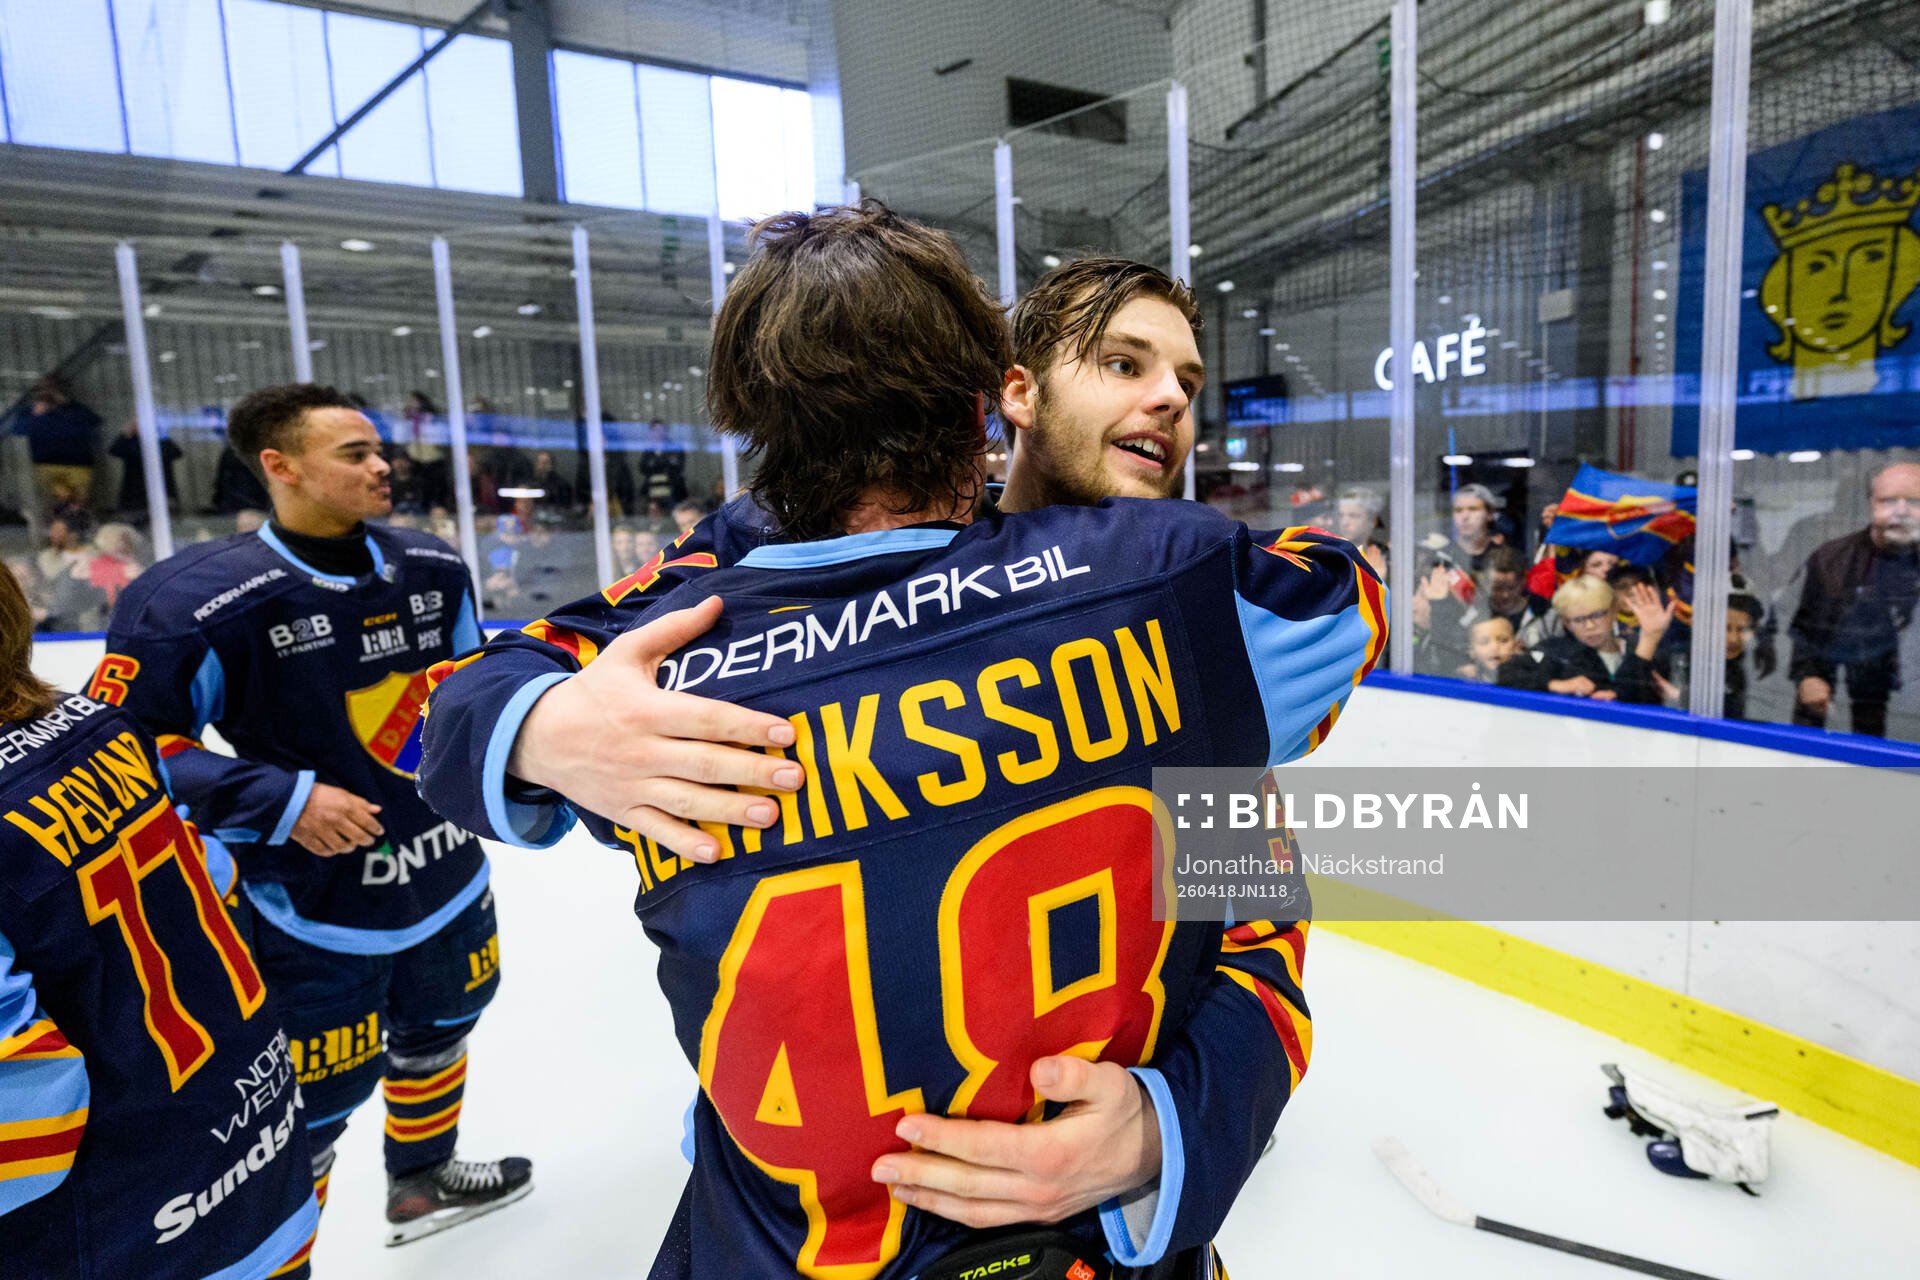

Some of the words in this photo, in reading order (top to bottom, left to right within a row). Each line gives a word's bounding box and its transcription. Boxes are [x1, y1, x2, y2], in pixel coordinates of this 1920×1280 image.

[1374, 317, 1486, 391] CAFÉ
[268, 613, 333, 650] B2B
[654, 564, 1002, 692] DERMARK
[1005, 547, 1091, 592] BIL
[614, 618, 1181, 895] IKSSON
[76, 794, 267, 1094] 77
[700, 786, 1177, 1280] 48
[959, 1254, 1032, 1280] TACKS
